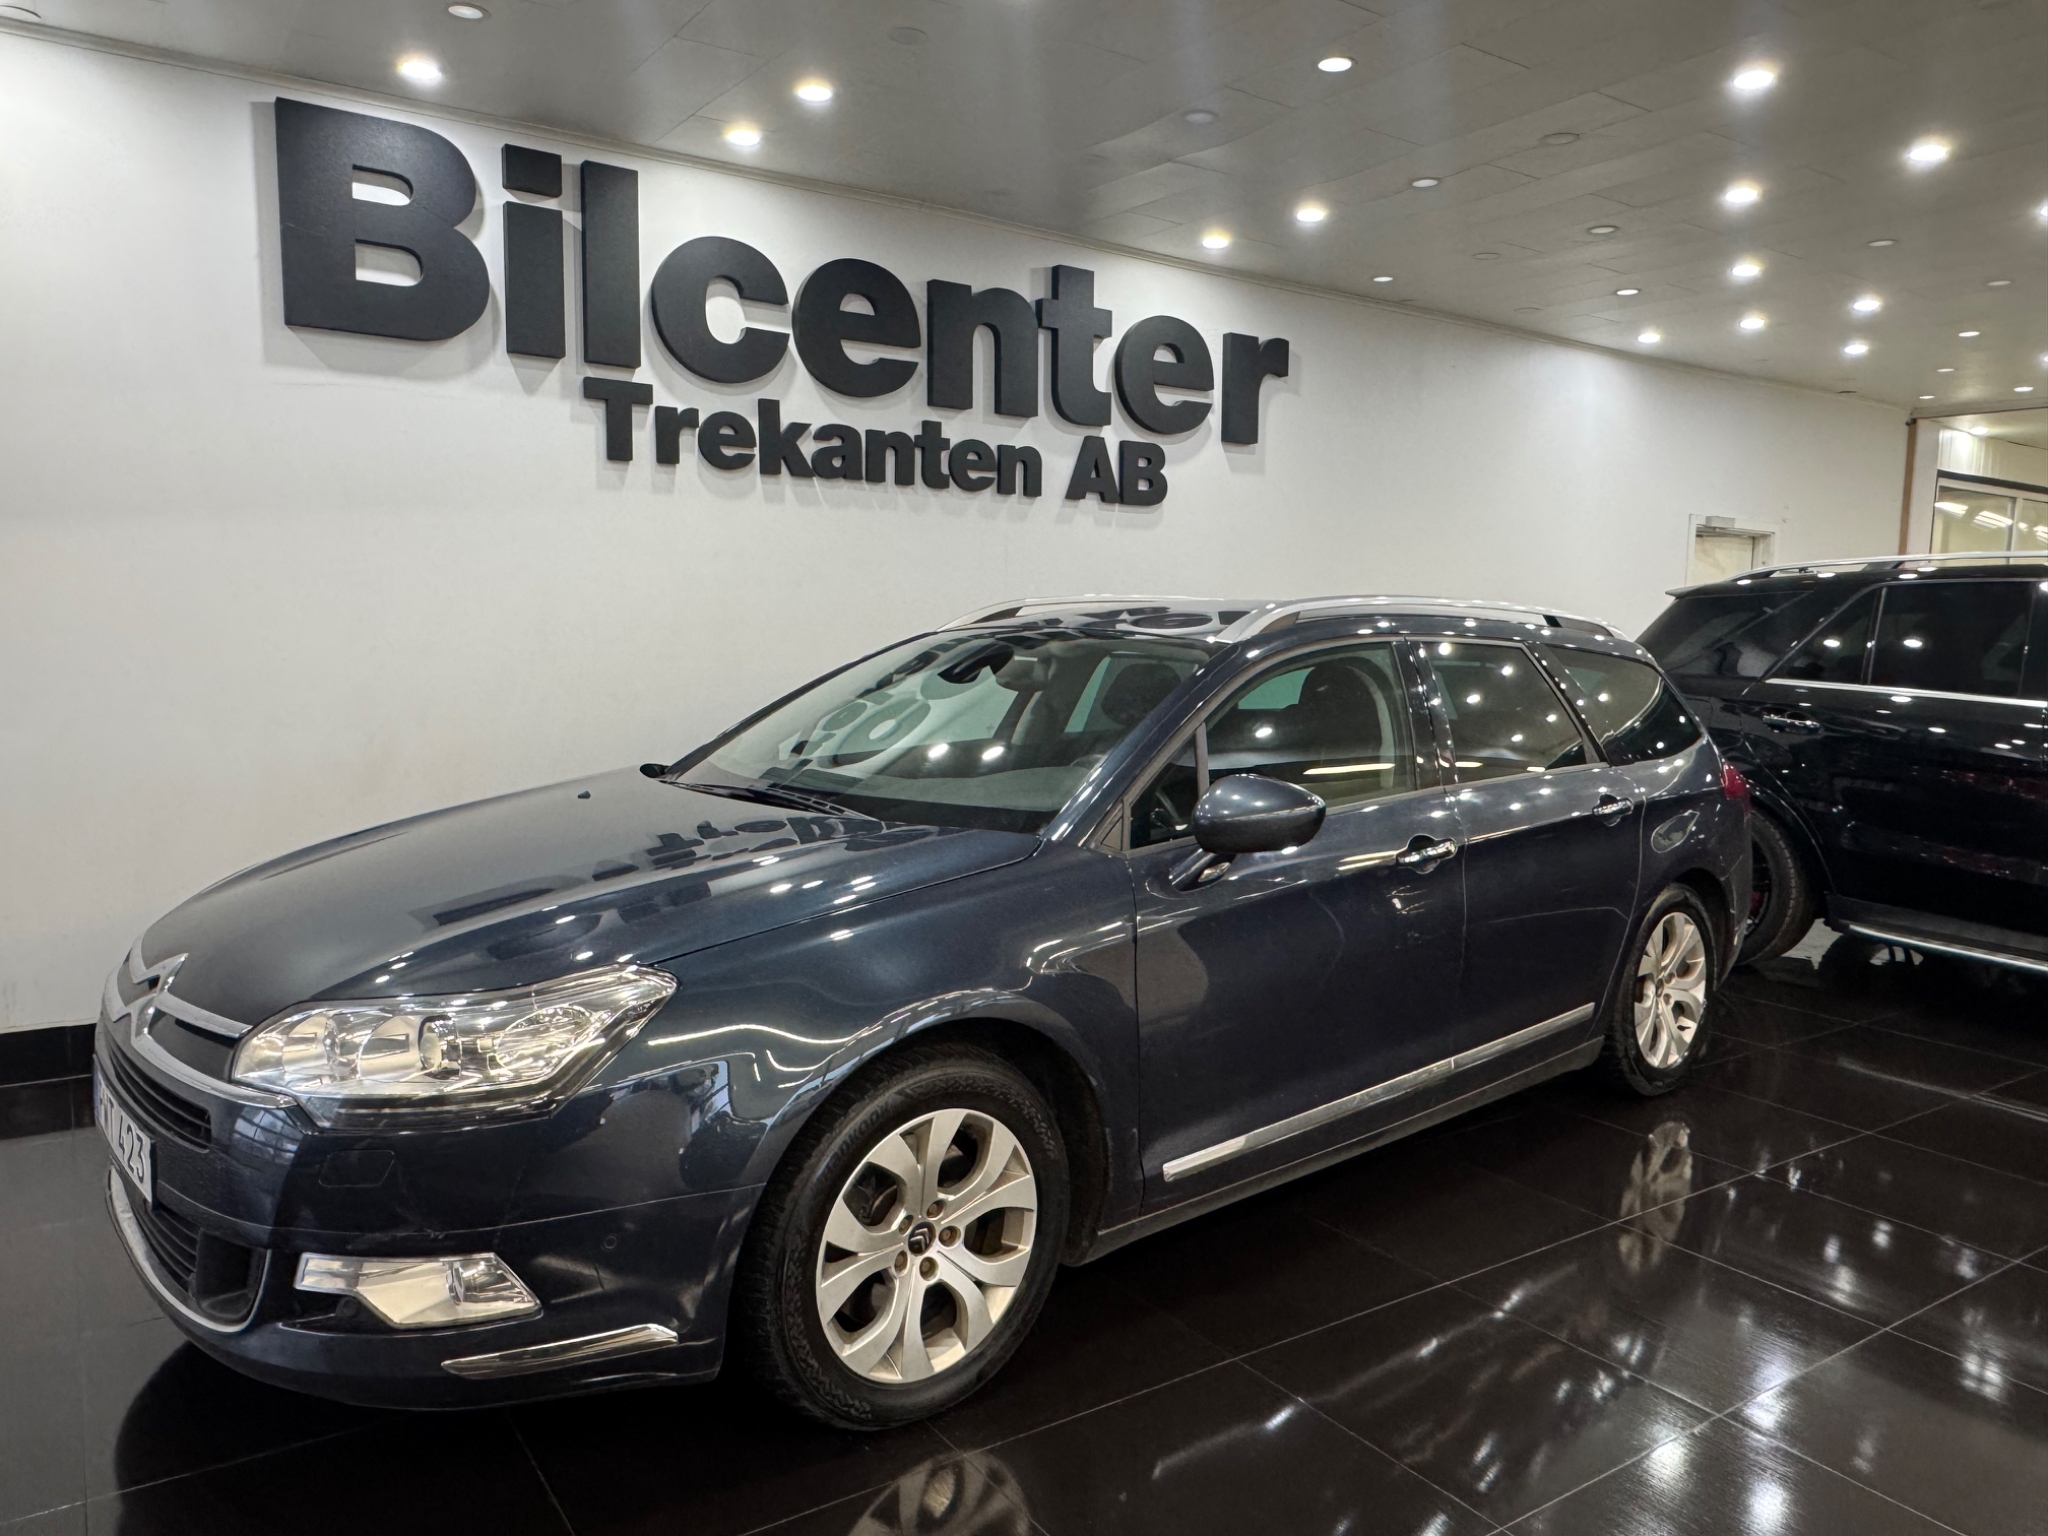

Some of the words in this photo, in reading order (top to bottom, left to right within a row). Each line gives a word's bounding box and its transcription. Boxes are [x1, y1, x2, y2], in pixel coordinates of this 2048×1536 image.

[275, 97, 1289, 445] Bilcenter
[583, 377, 1042, 497] Trekanten
[1065, 436, 1168, 506] AB
[119, 1115, 144, 1184] 423
